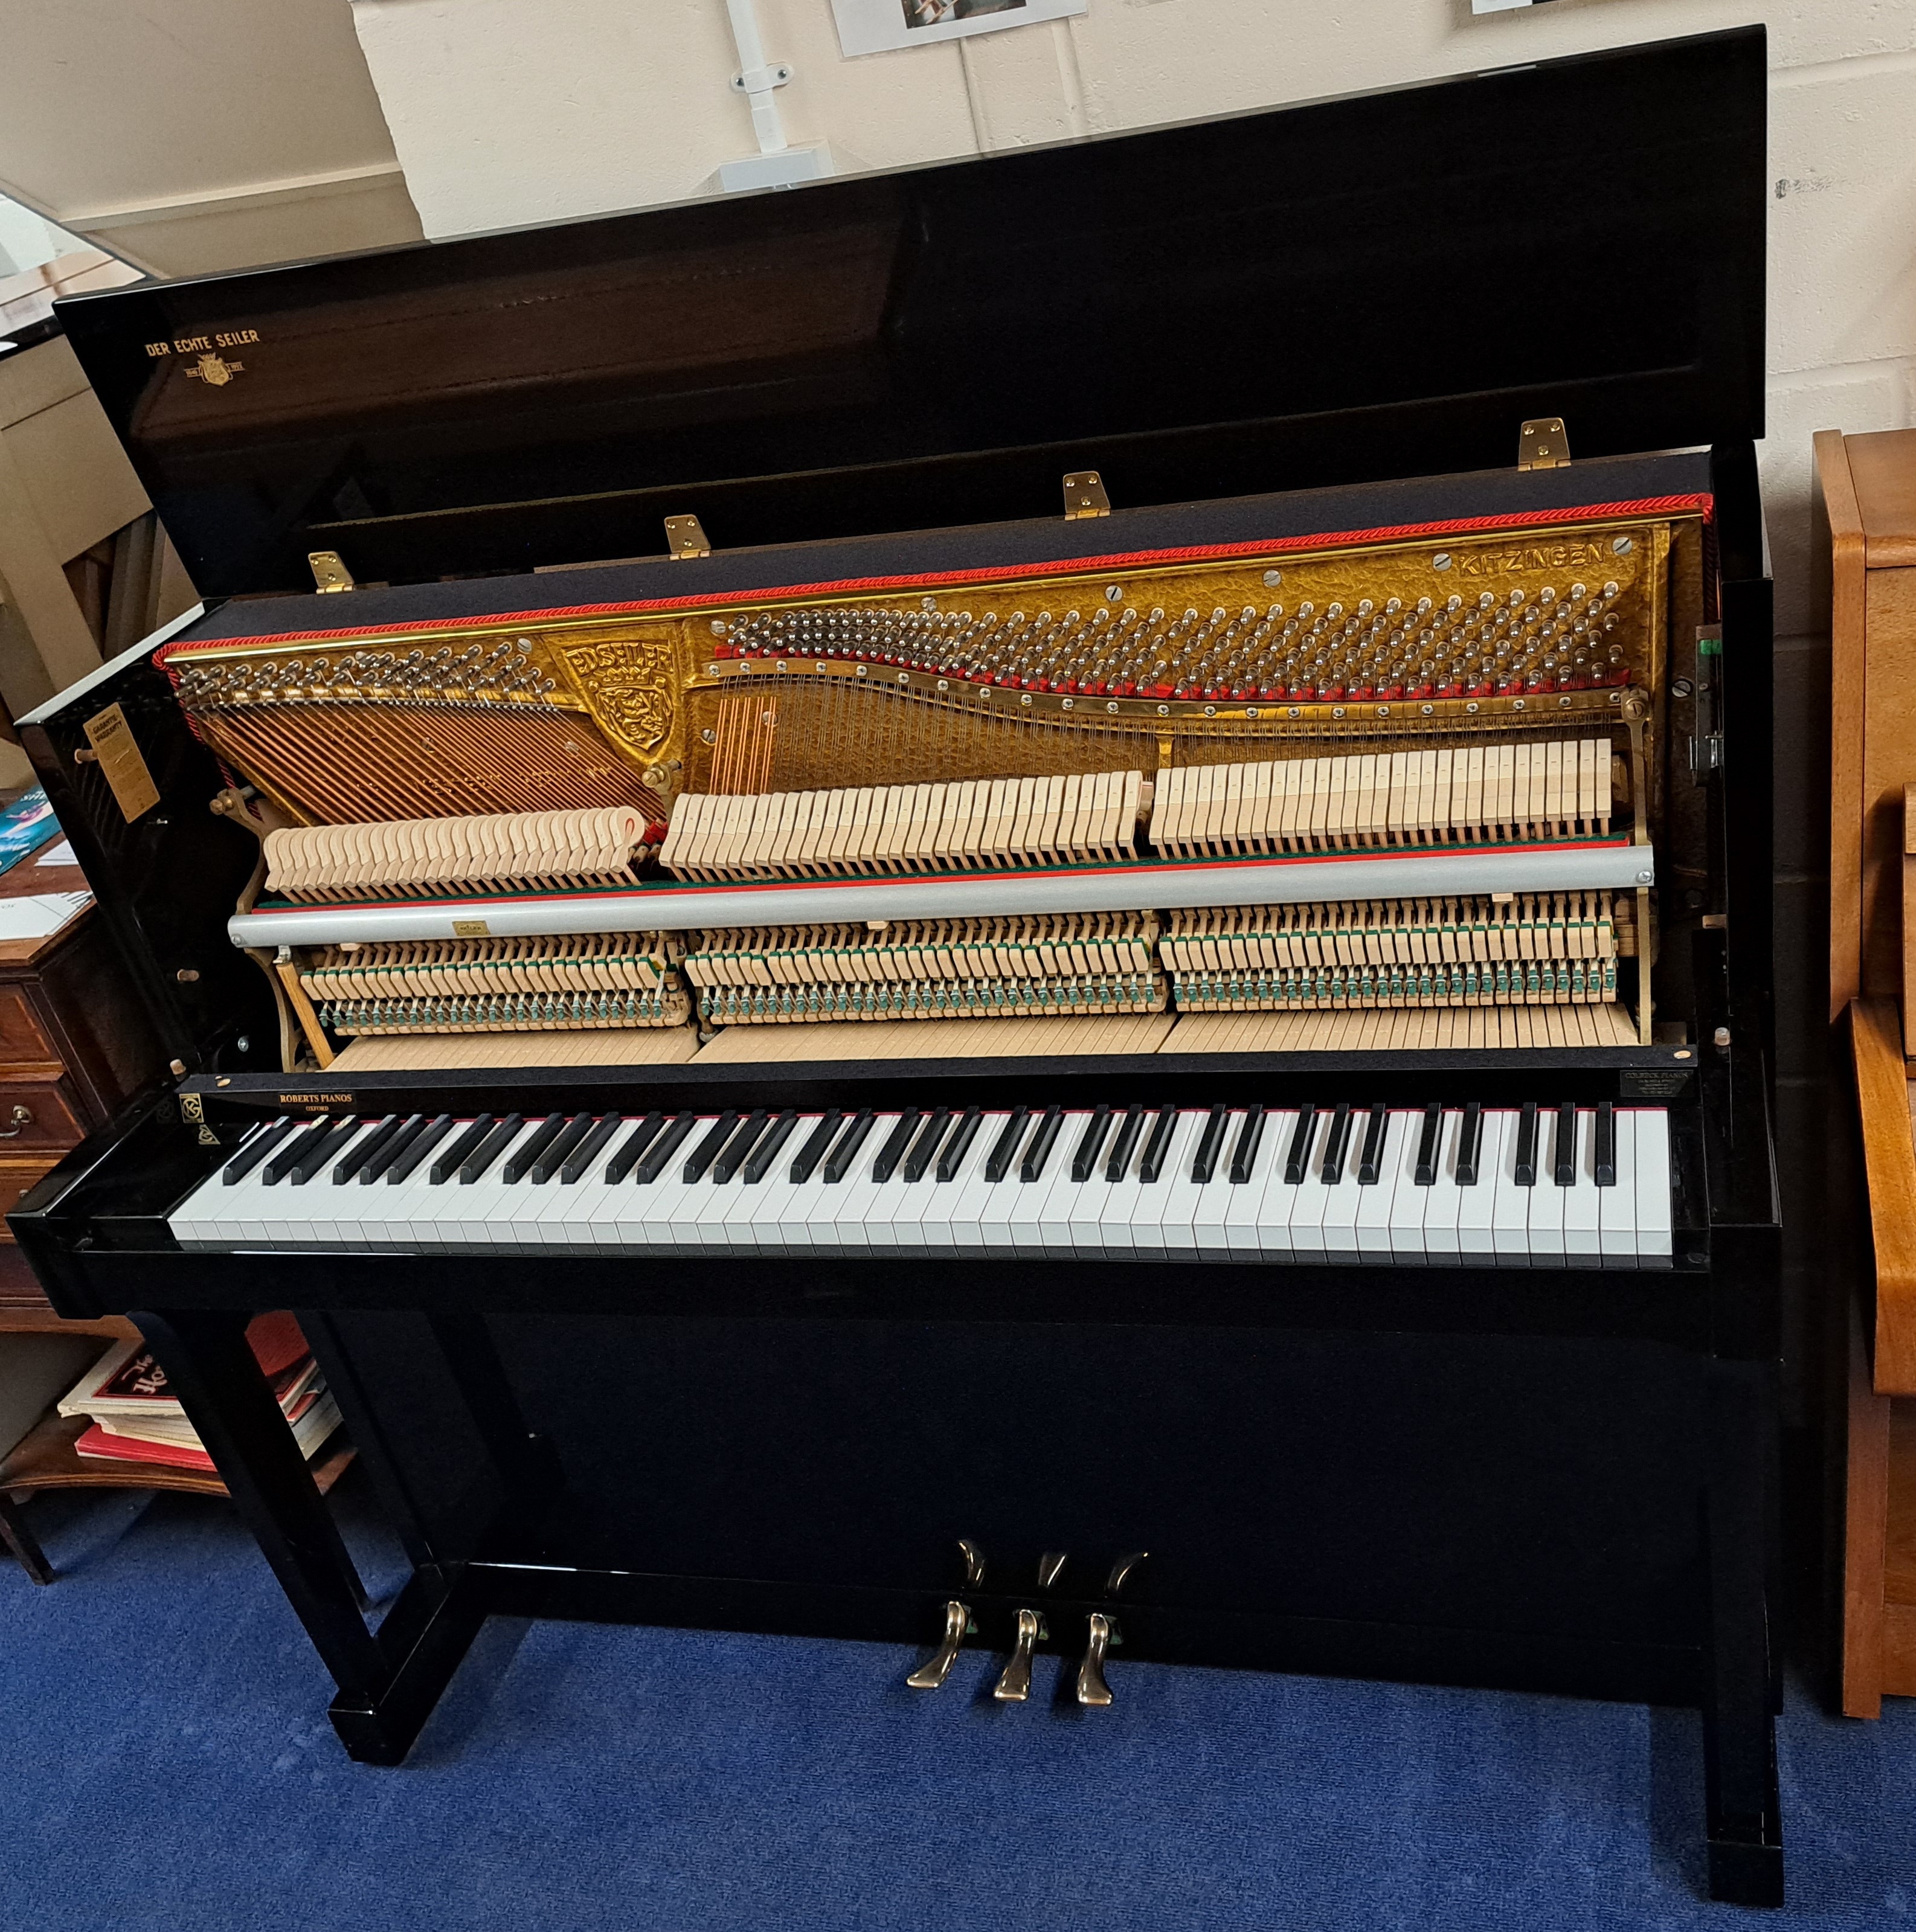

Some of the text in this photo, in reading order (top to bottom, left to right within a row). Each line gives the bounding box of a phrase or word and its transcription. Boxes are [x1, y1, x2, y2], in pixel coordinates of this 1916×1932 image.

[145, 329, 261, 357] DER ECHTE SEILER
[1459, 542, 1604, 576] KITZINGEN
[280, 1094, 352, 1103] ROBERTS PIANOS
